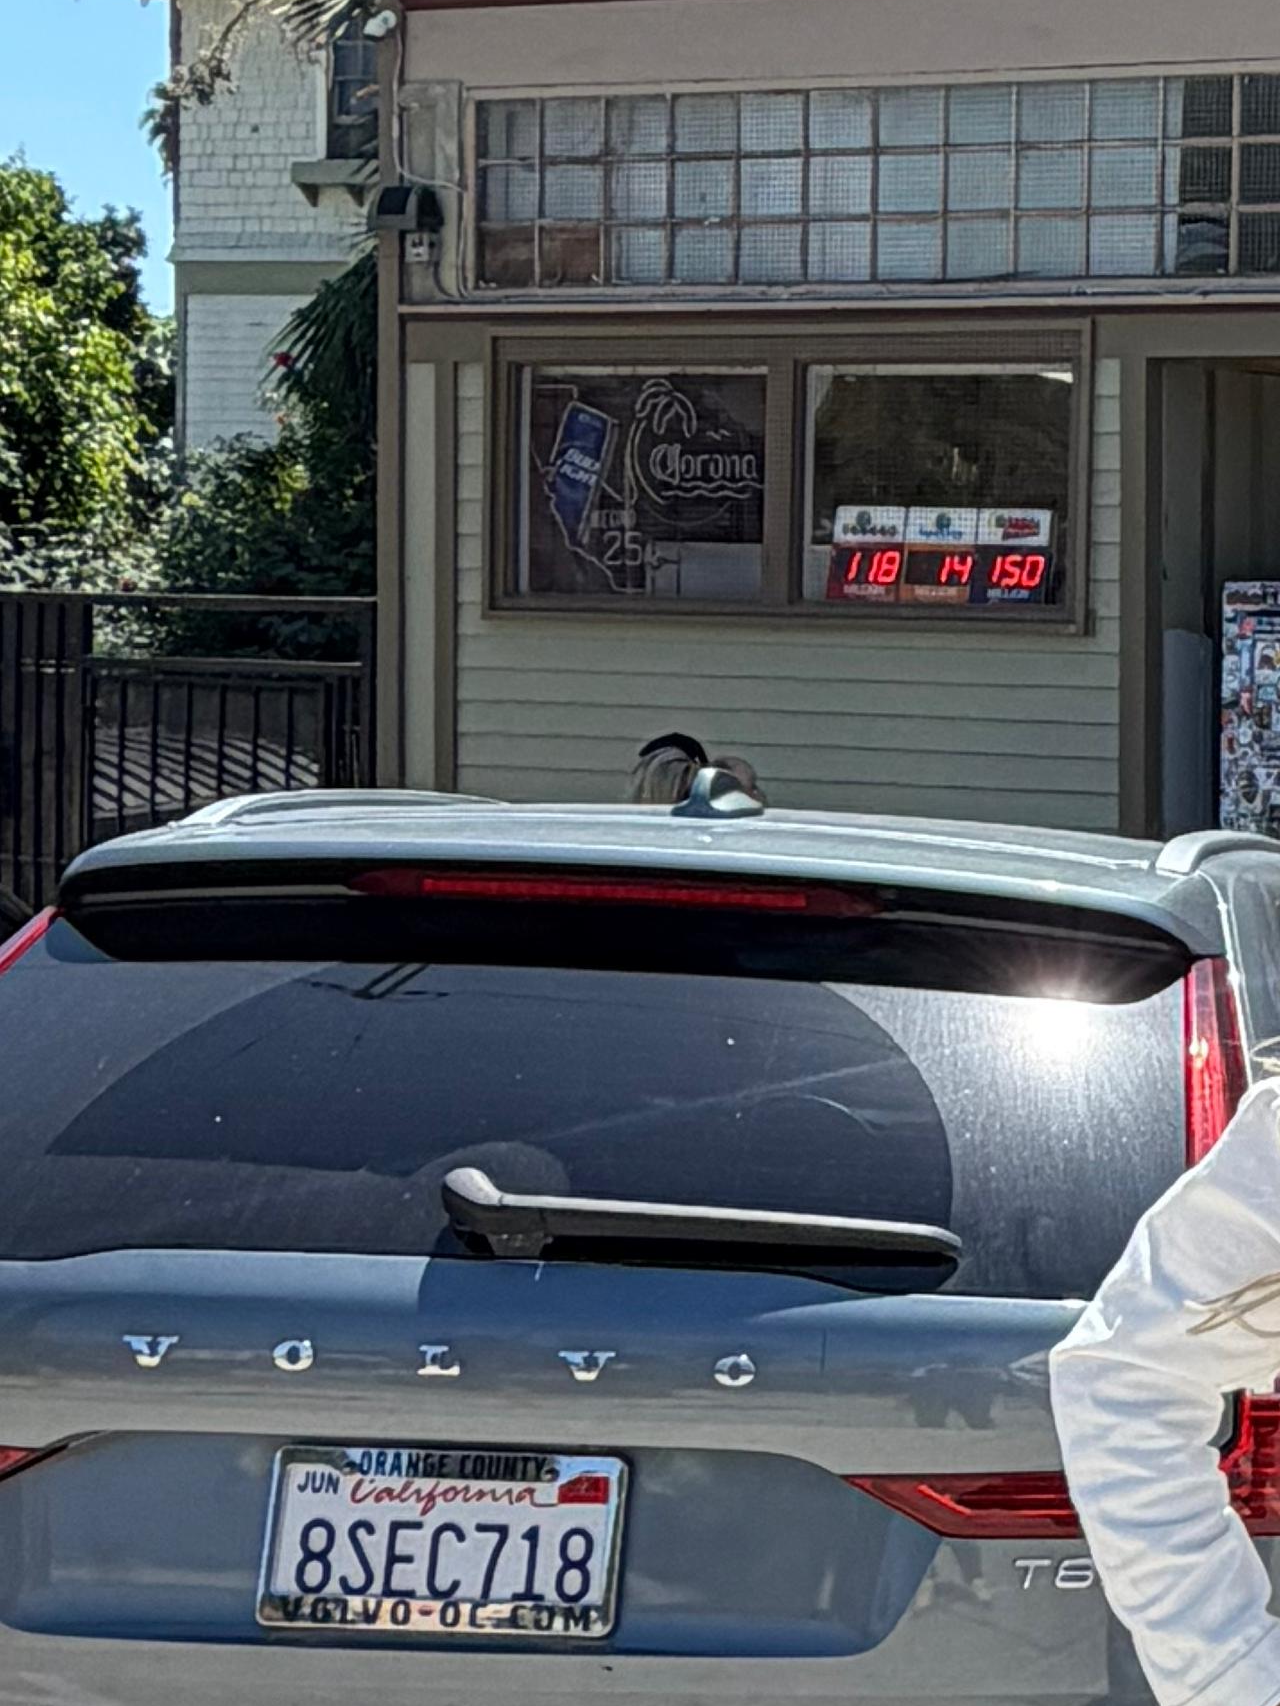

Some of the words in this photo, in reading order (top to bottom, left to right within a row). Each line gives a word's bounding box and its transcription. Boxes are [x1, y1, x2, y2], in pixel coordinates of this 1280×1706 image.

[649, 443, 758, 485] Corona
[846, 550, 901, 584] 118
[938, 553, 973, 584] 14
[990, 553, 1046, 586] 150
[121, 1333, 757, 1388] VOLVO
[357, 1449, 449, 1480] ORANGE
[458, 1453, 547, 1481] COUNTY
[297, 1470, 341, 1495] JUN
[349, 1477, 557, 1517] California
[294, 1517, 595, 1604] 8SEC718
[1014, 1557, 1095, 1590] T6
